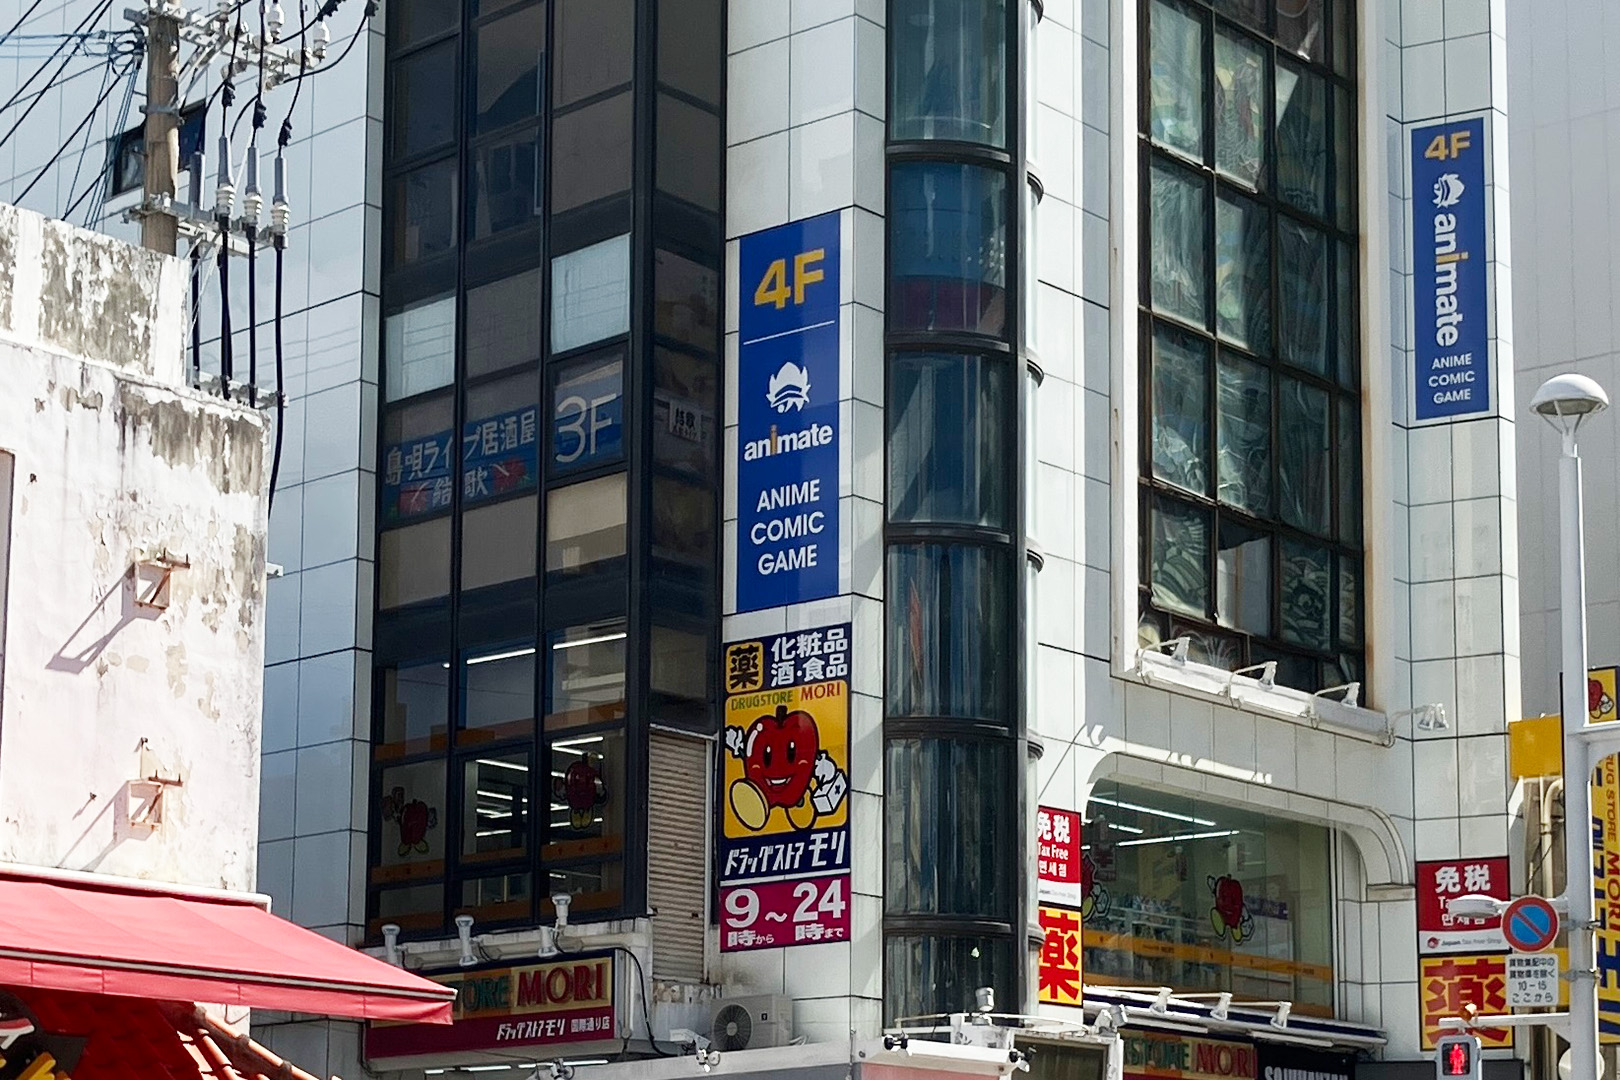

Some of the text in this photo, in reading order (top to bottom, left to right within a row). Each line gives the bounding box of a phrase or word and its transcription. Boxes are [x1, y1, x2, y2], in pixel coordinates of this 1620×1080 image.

[1425, 130, 1471, 161] 4F
[754, 248, 825, 310] 4F
[1433, 212, 1469, 347] animate
[1431, 353, 1473, 370] ANIME
[1428, 370, 1476, 388] COMIC
[1433, 388, 1472, 404] GAME
[556, 394, 617, 463] 3F
[744, 423, 833, 461] animate
[757, 479, 820, 512] ANIME
[751, 511, 824, 545] COMIC
[758, 544, 817, 575] GAME
[771, 628, 848, 662] 化粧品
[729, 645, 760, 689] 薬
[771, 653, 848, 687] 酒・食品
[731, 682, 840, 711] DRUGSTORE MORI
[1605, 753, 1616, 785] RUG
[1038, 811, 1071, 844] 免税
[1605, 791, 1617, 843] STORE
[1051, 844, 1068, 860] Free
[1435, 864, 1491, 893] 免税
[1606, 851, 1620, 932] MORI
[727, 923, 844, 948] 時から 時まで
[516, 962, 606, 1008] MORI
[1512, 992, 1553, 1003] ここから
[1195, 1042, 1258, 1080] MORI
